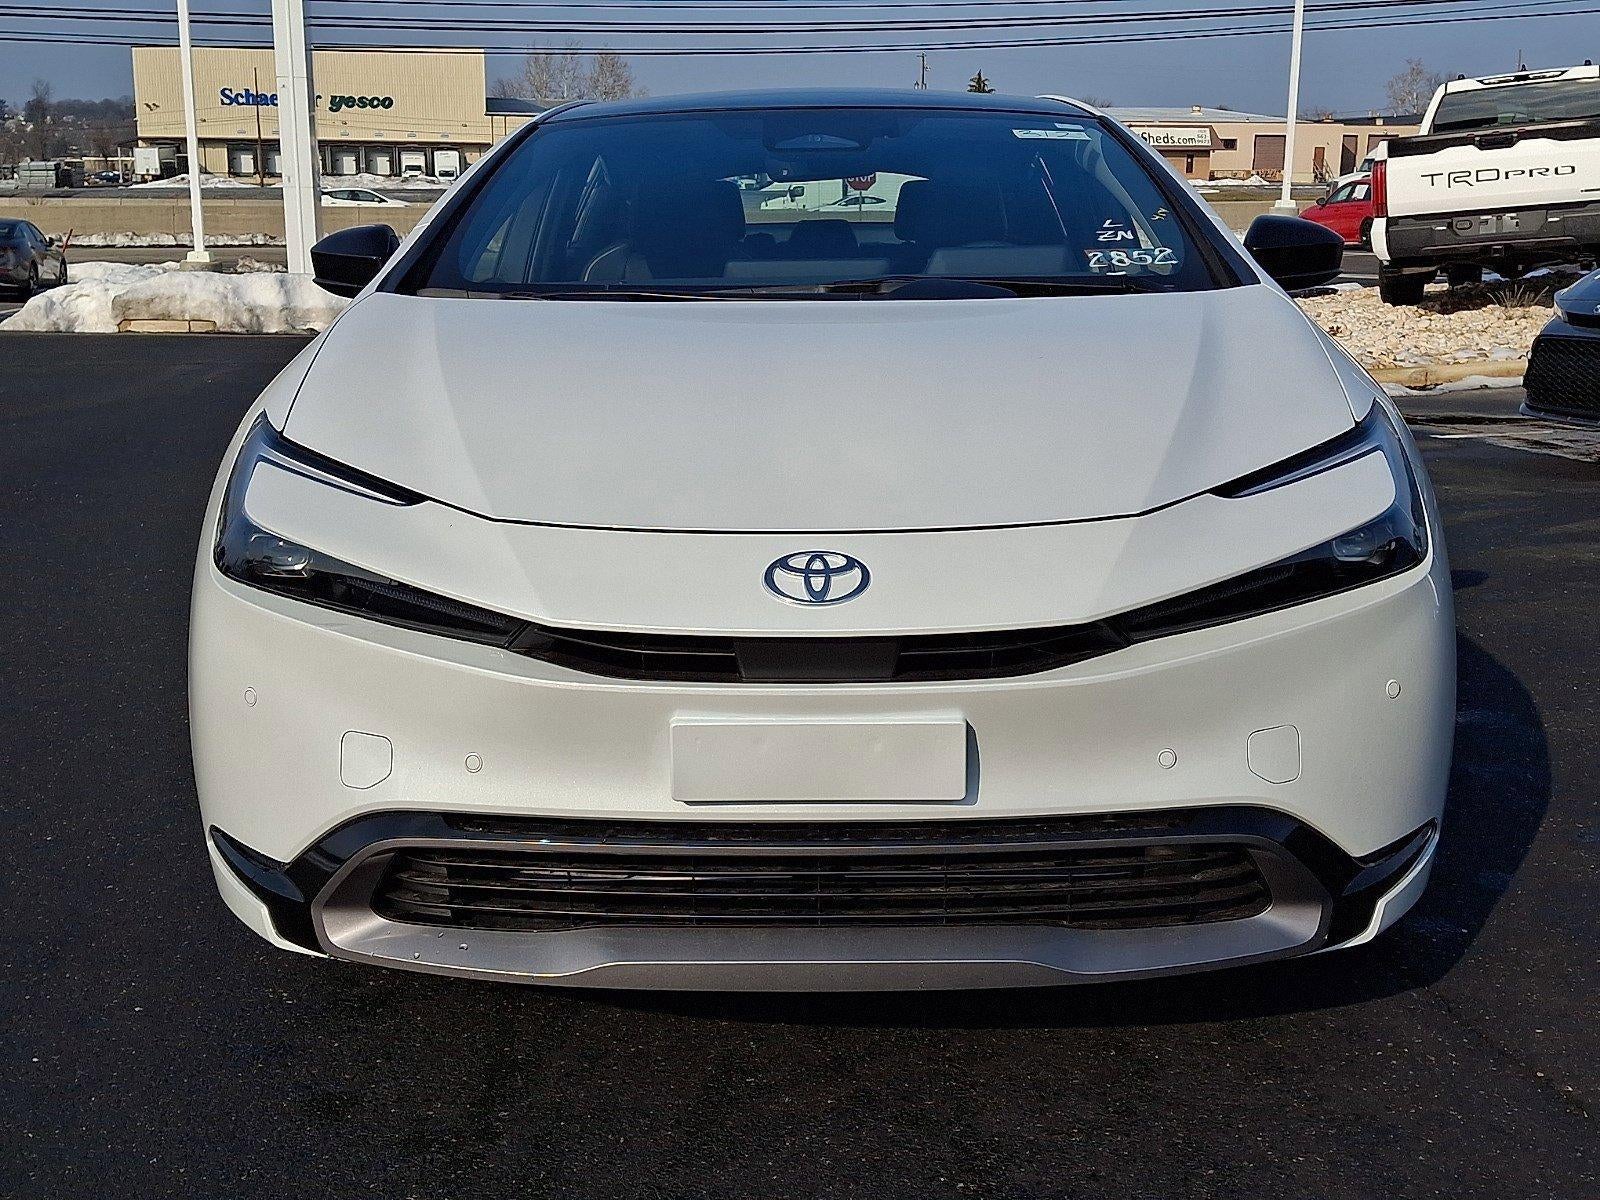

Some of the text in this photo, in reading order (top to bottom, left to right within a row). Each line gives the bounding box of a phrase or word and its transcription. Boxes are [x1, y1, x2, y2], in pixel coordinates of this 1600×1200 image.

[328, 95, 394, 112] yesco
[1420, 165, 1576, 189] TRD PRO
[1088, 247, 1179, 268] 2852
